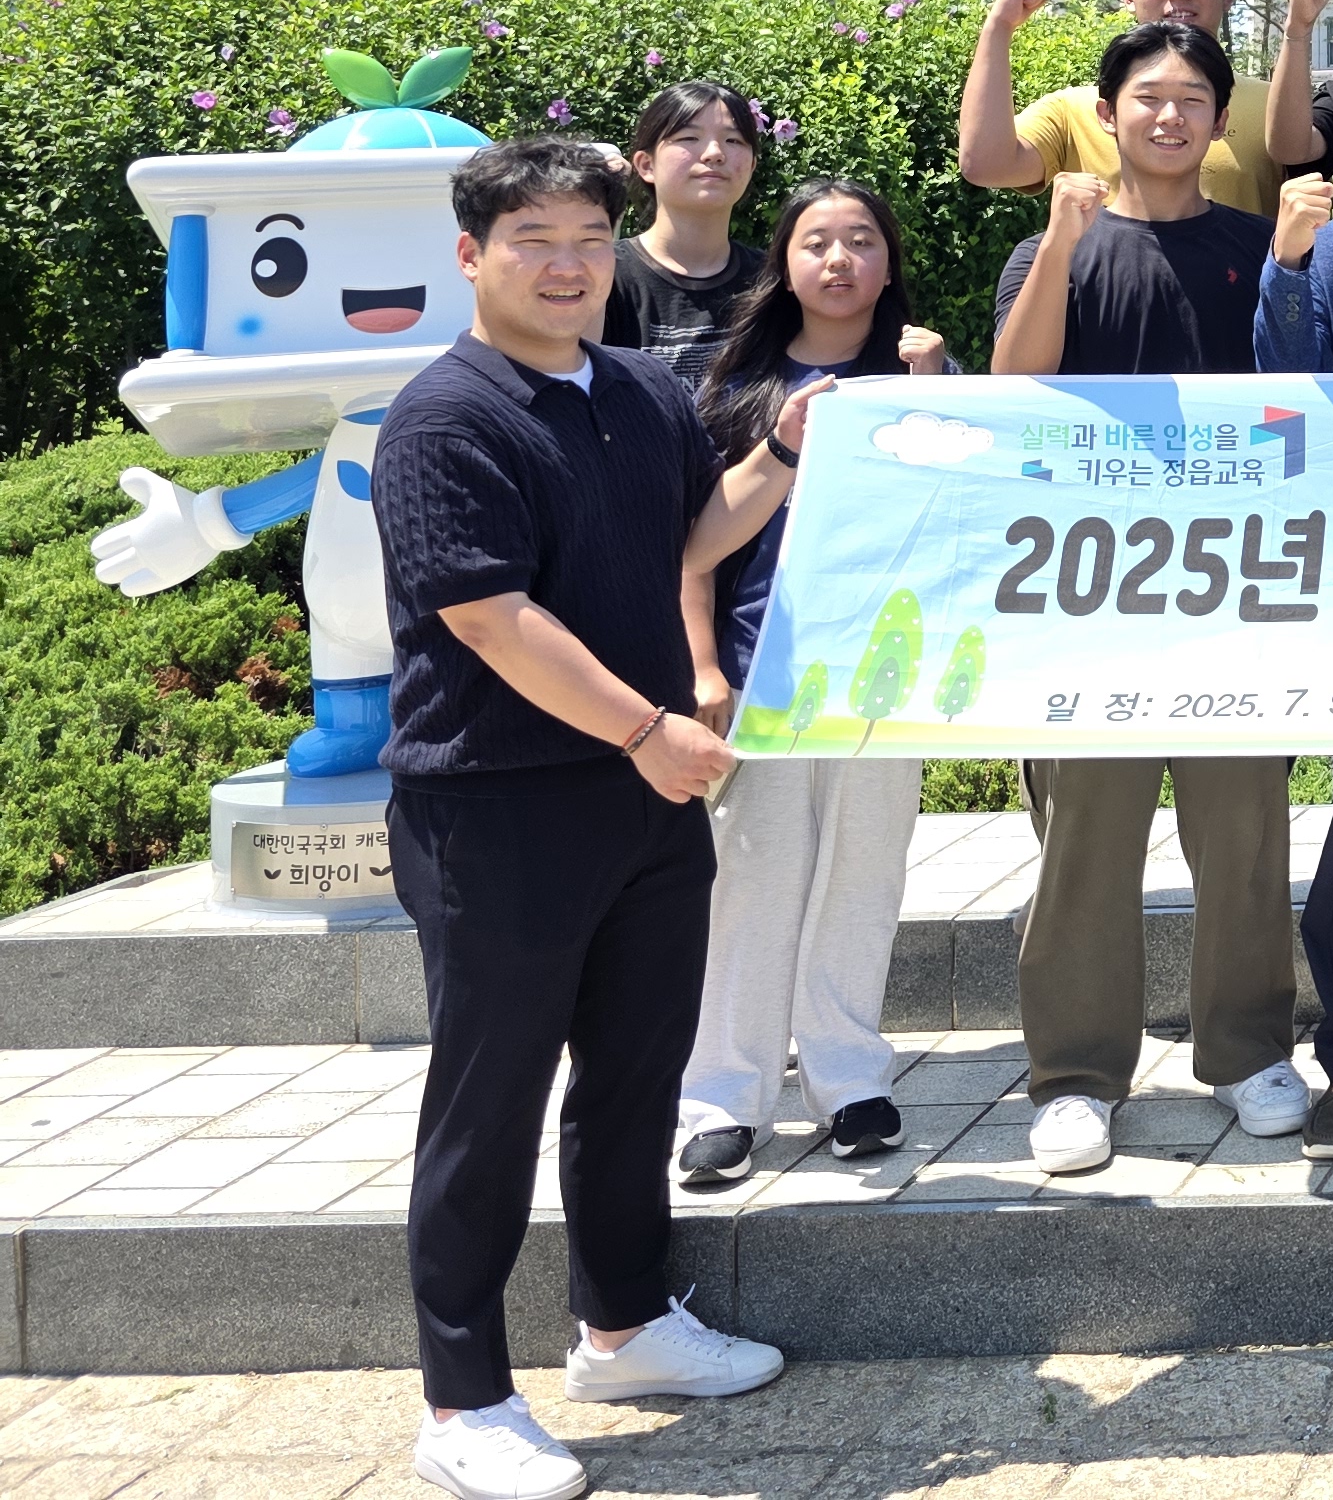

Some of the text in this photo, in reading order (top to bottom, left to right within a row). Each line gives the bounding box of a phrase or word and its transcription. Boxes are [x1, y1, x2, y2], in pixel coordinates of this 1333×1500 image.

[1020, 422, 1239, 451] 실력과 바른 인성을
[1077, 457, 1265, 487] 키우는 정읍교육
[994, 509, 1327, 622] 2025년
[1168, 693, 1264, 718] 2025.
[1285, 688, 1309, 718] 7.
[252, 833, 346, 855] 대한민국국회
[289, 863, 359, 892] 희망이
